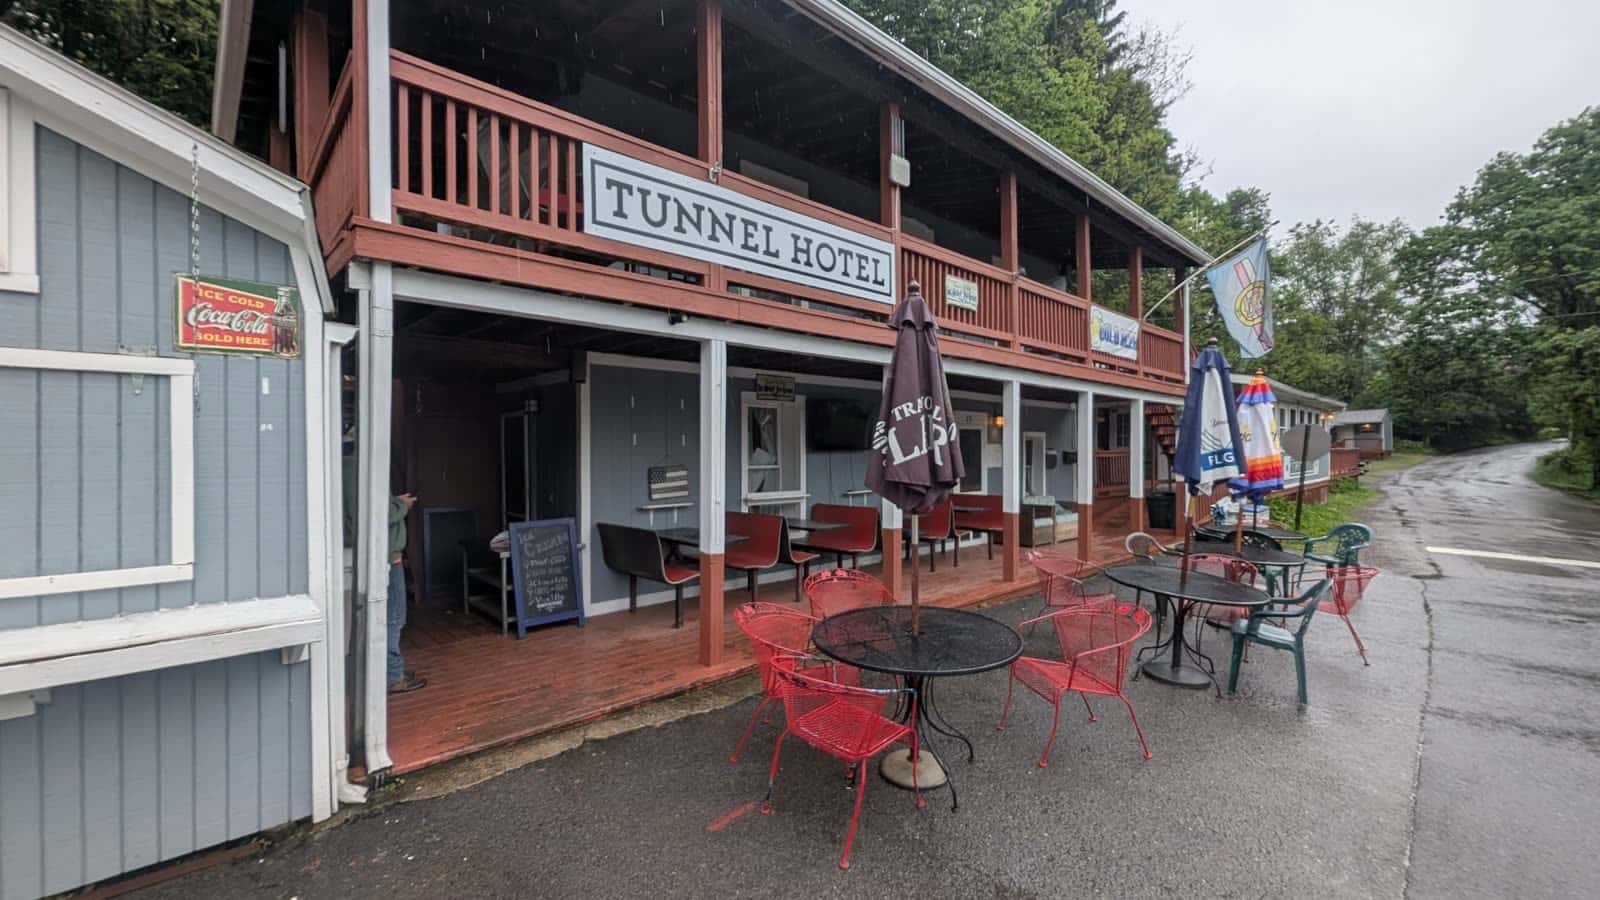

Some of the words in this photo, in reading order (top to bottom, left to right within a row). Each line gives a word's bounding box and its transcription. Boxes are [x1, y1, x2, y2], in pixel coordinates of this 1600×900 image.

[605, 177, 780, 260] TUNNEL
[790, 232, 886, 287] HOTEL
[197, 288, 225, 301] ICE
[227, 294, 265, 309] COLD
[195, 333, 233, 343] SOLD
[235, 336, 271, 346] HERE
